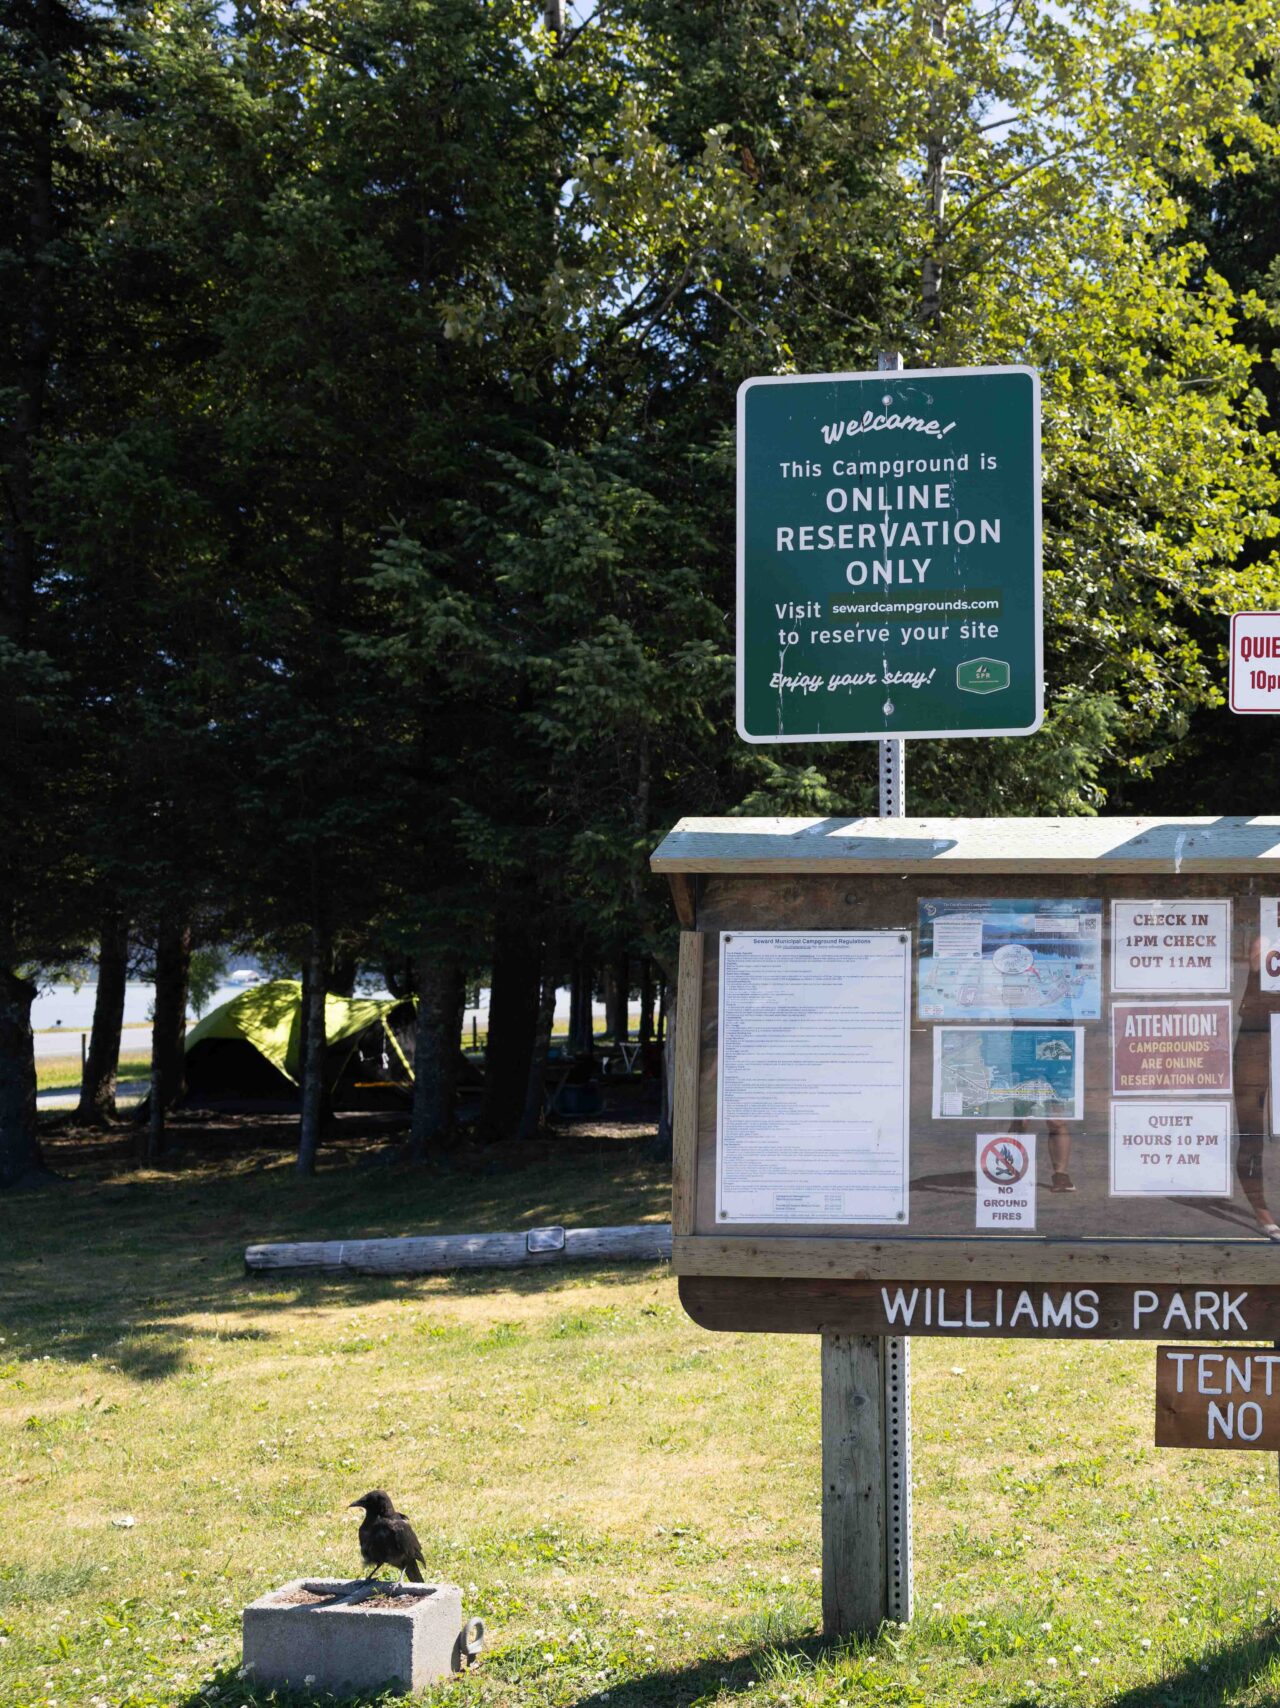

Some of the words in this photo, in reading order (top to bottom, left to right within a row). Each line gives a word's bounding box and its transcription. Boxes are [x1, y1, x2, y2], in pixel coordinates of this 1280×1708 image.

[821, 410, 956, 444] Welcome!
[780, 461, 822, 478] This
[832, 454, 969, 478] Campground
[980, 453, 997, 470] is
[826, 484, 951, 513] ONLINE
[776, 519, 1001, 551] RESERVATION
[846, 558, 931, 586] ONLY
[775, 601, 822, 619] Visit
[832, 598, 999, 615] sewardcampgrounds.com
[779, 628, 799, 645] to
[810, 626, 890, 644] reserve
[901, 625, 950, 646] your
[960, 621, 999, 639] site
[769, 672, 824, 695] Enjoy
[827, 671, 877, 690] your
[882, 668, 936, 689] stay!
[1133, 914, 1187, 926] CHECK
[1191, 914, 1209, 926] IN
[1126, 935, 1158, 947] 1PM
[1163, 935, 1217, 947] CHECK
[1130, 956, 1164, 968] OUT
[1169, 956, 1212, 968] 11AM
[1124, 1014, 1217, 1037] ATTENTION!
[1129, 1041, 1210, 1054] CAMPGROUNDS
[1141, 1058, 1163, 1069] ARE
[1165, 1057, 1203, 1069] ONLINE
[1120, 1074, 1194, 1086] RESERVATION
[1197, 1073, 1224, 1085] ONLY
[1148, 1115, 1193, 1128] QUIET
[1122, 1135, 1172, 1146] HOURS
[1177, 1135, 1192, 1146] 10
[1196, 1135, 1218, 1146] PM
[1141, 1153, 1160, 1165] TO
[1165, 1154, 1172, 1165] 7
[1177, 1154, 1200, 1165] AM
[998, 1186, 1013, 1194] NO
[983, 1199, 1027, 1208] GROUND
[992, 1212, 1022, 1221] FIRES
[881, 1287, 1100, 1328] WILLIAMS
[1133, 1290, 1249, 1331] PARK
[1207, 1401, 1263, 1441] NO
